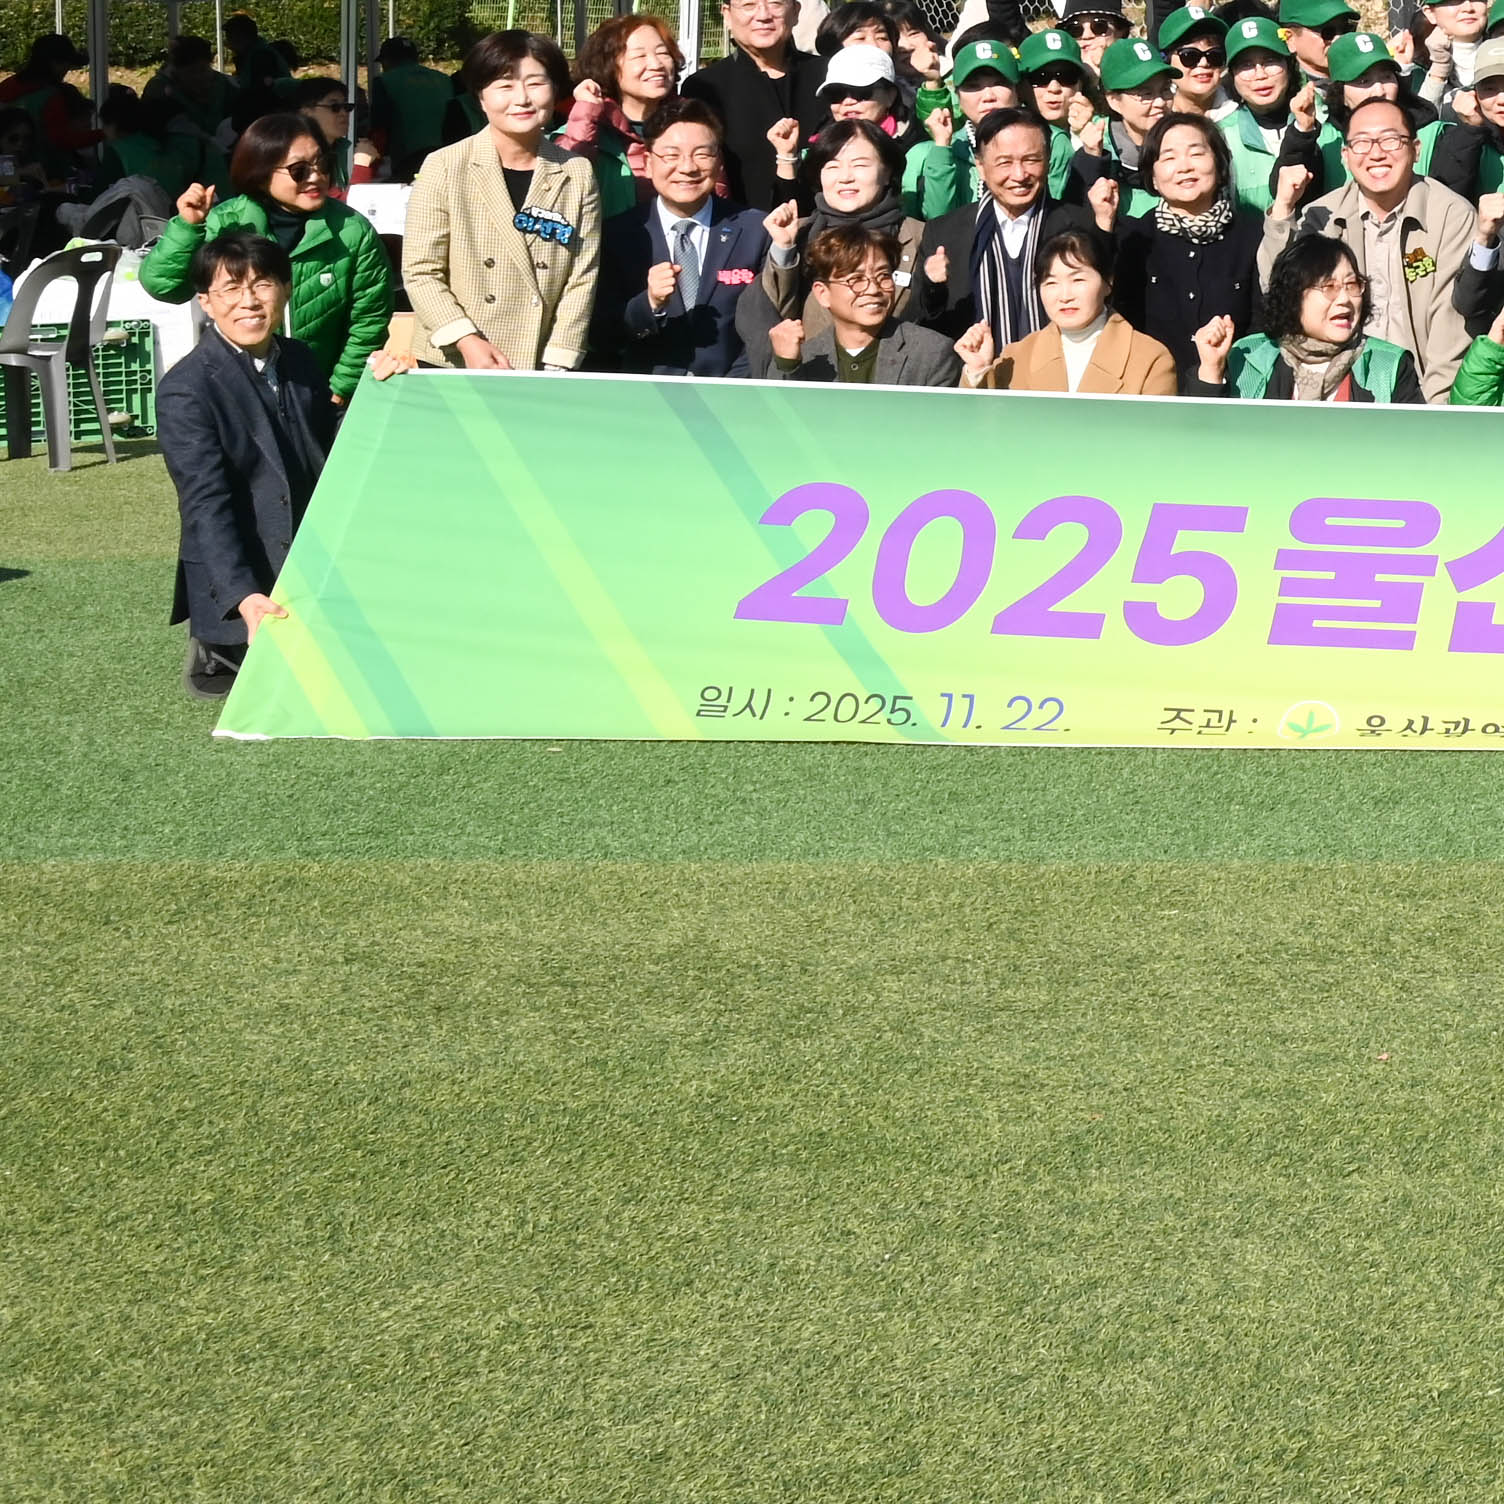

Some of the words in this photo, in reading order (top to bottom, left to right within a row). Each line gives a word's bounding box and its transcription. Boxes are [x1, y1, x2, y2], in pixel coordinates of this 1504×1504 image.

[1240, 21, 1258, 39] C
[975, 42, 992, 59] C
[1045, 32, 1062, 50] C
[1355, 34, 1374, 53] C
[1133, 42, 1152, 61] C
[695, 684, 773, 721] 일시
[802, 690, 918, 727] 2025.
[939, 691, 982, 730] 11.
[999, 695, 1072, 733] 22.
[1156, 706, 1238, 736] 주관
